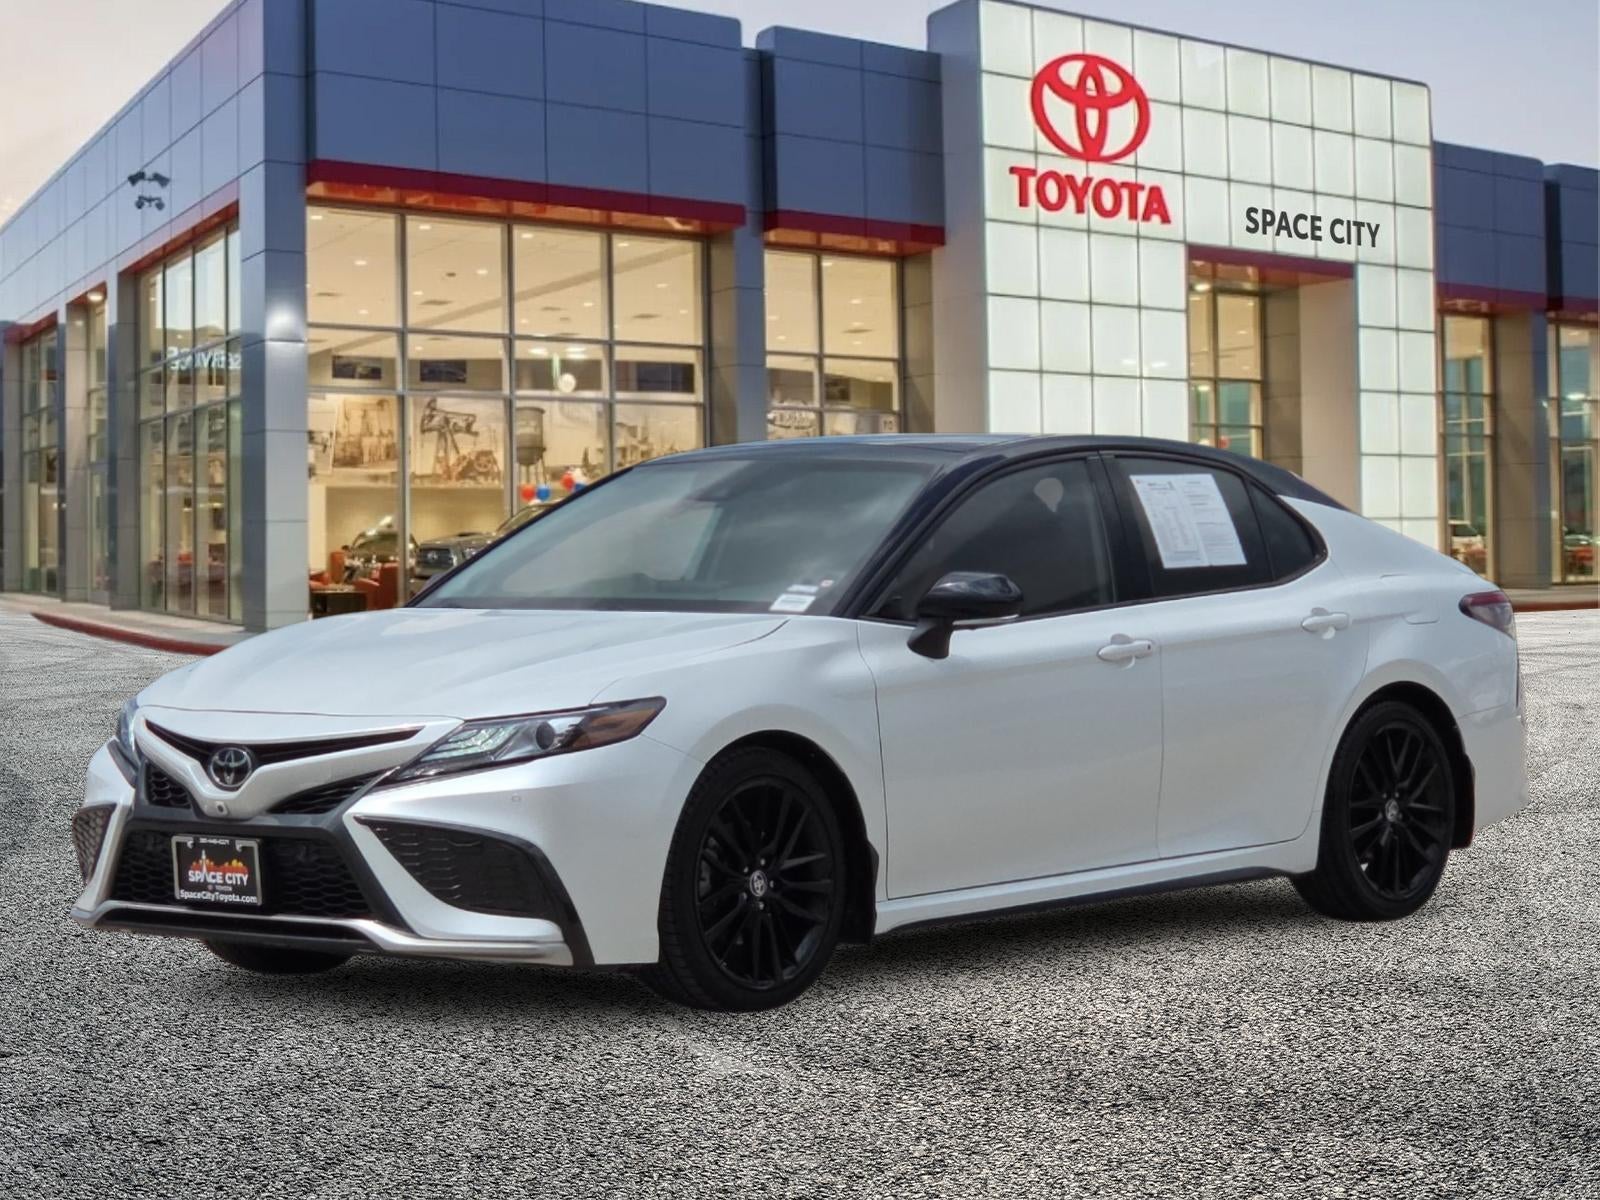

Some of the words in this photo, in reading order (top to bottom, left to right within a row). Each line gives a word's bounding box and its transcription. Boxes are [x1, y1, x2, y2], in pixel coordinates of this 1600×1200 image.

[1009, 166, 1171, 224] TOYOTA
[1245, 206, 1322, 242] SPACE
[1329, 218, 1380, 248] CITY
[188, 869, 223, 883] SPACE
[225, 872, 248, 886] CITY
[180, 889, 257, 903] SpaceCityToyota.com
